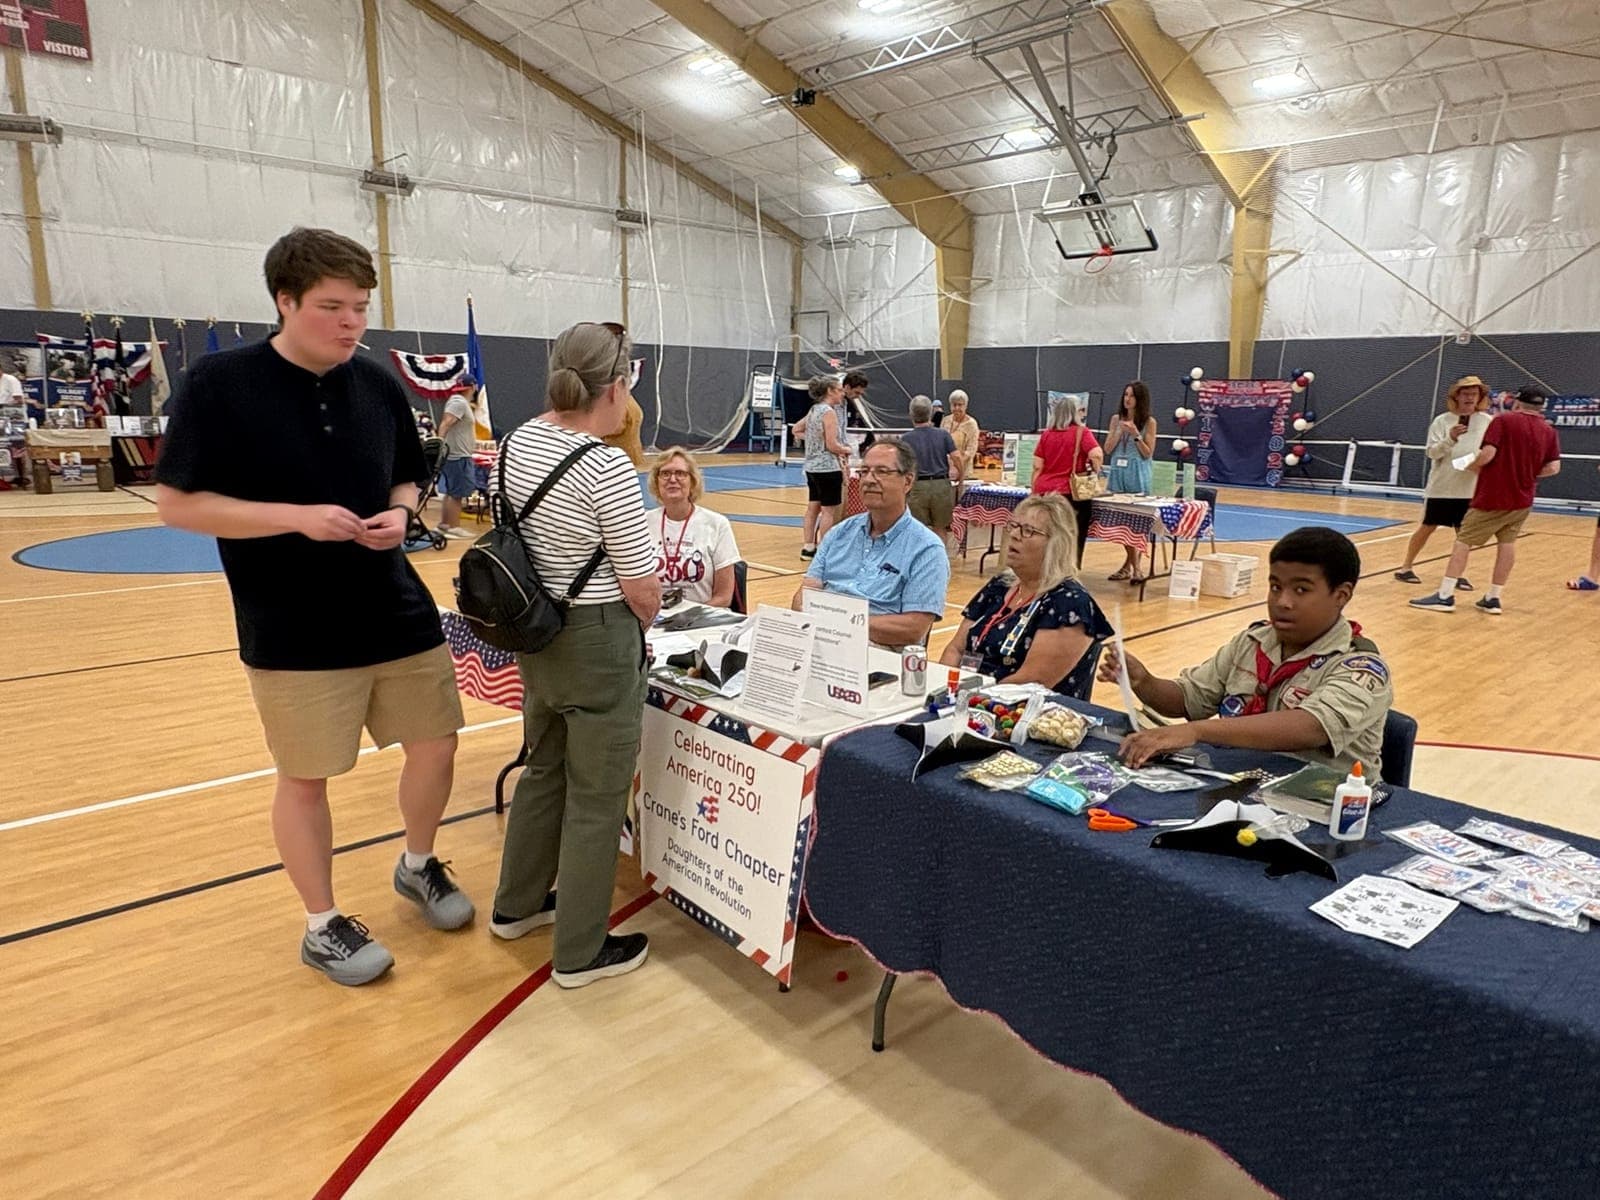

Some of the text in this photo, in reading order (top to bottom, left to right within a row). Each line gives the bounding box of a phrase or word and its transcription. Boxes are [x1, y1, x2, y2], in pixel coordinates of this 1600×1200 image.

[43, 40, 89, 59] VISITOR
[666, 755, 762, 815] America 250!
[674, 729, 756, 786] Celebrating
[643, 791, 786, 887] Crane's Ford Chapter
[667, 837, 744, 895] Daughters of the
[661, 852, 752, 920] American Revolution
